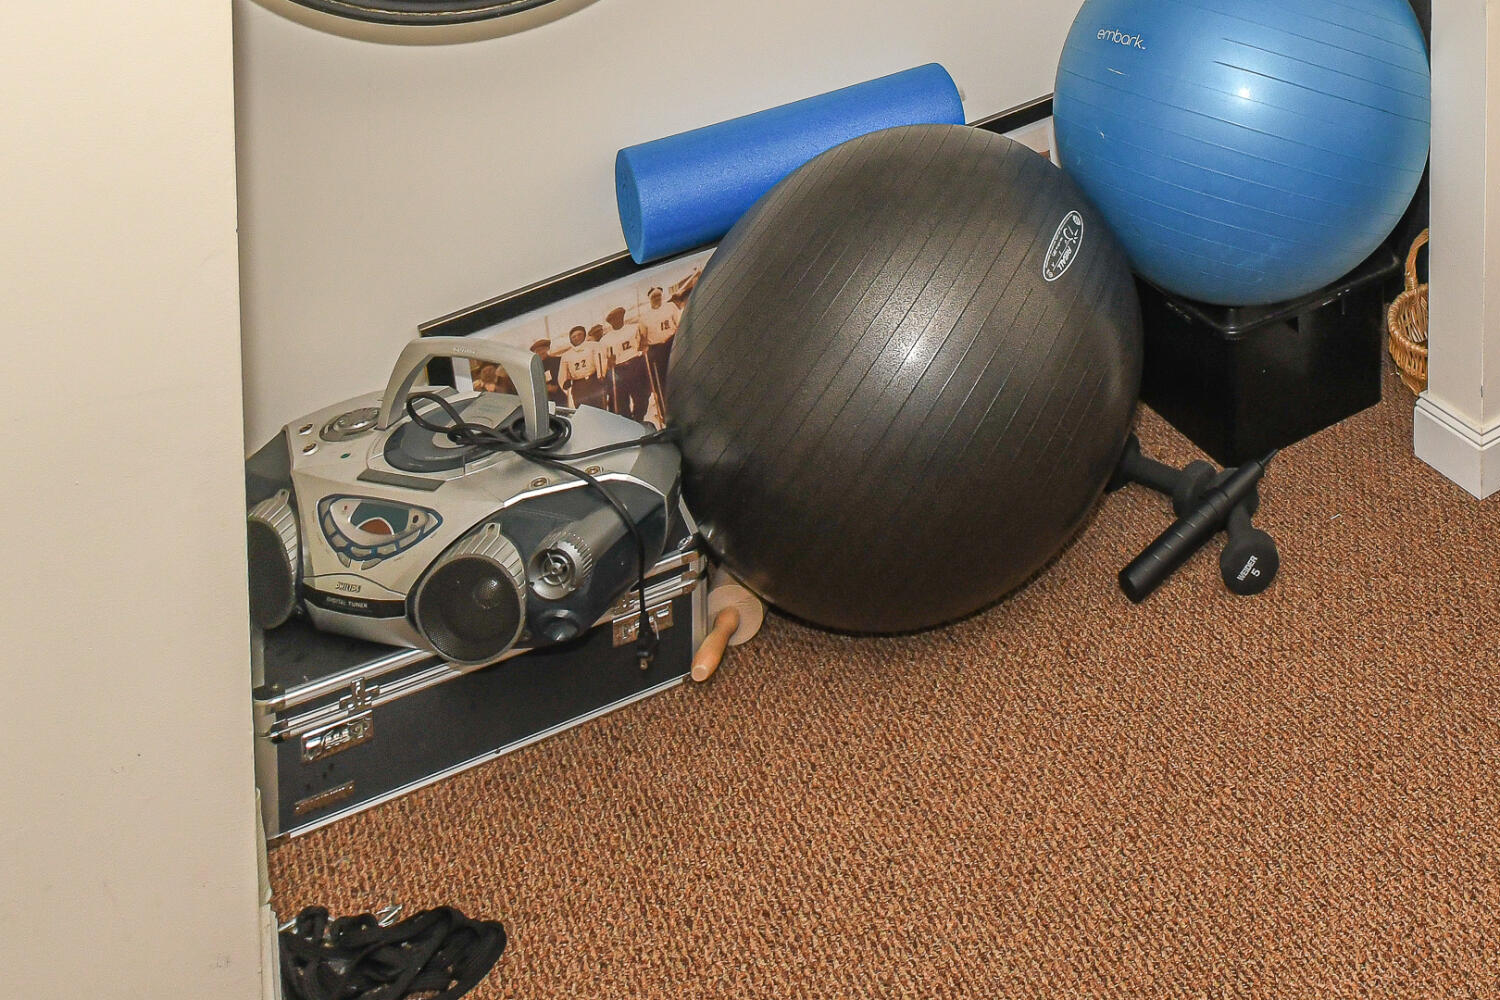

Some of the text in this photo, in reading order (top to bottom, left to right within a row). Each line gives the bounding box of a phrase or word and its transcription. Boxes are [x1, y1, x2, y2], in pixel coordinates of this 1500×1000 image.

[1096, 28, 1144, 49] embark
[1236, 555, 1258, 581] WEIDER
[1251, 568, 1261, 577] 5
